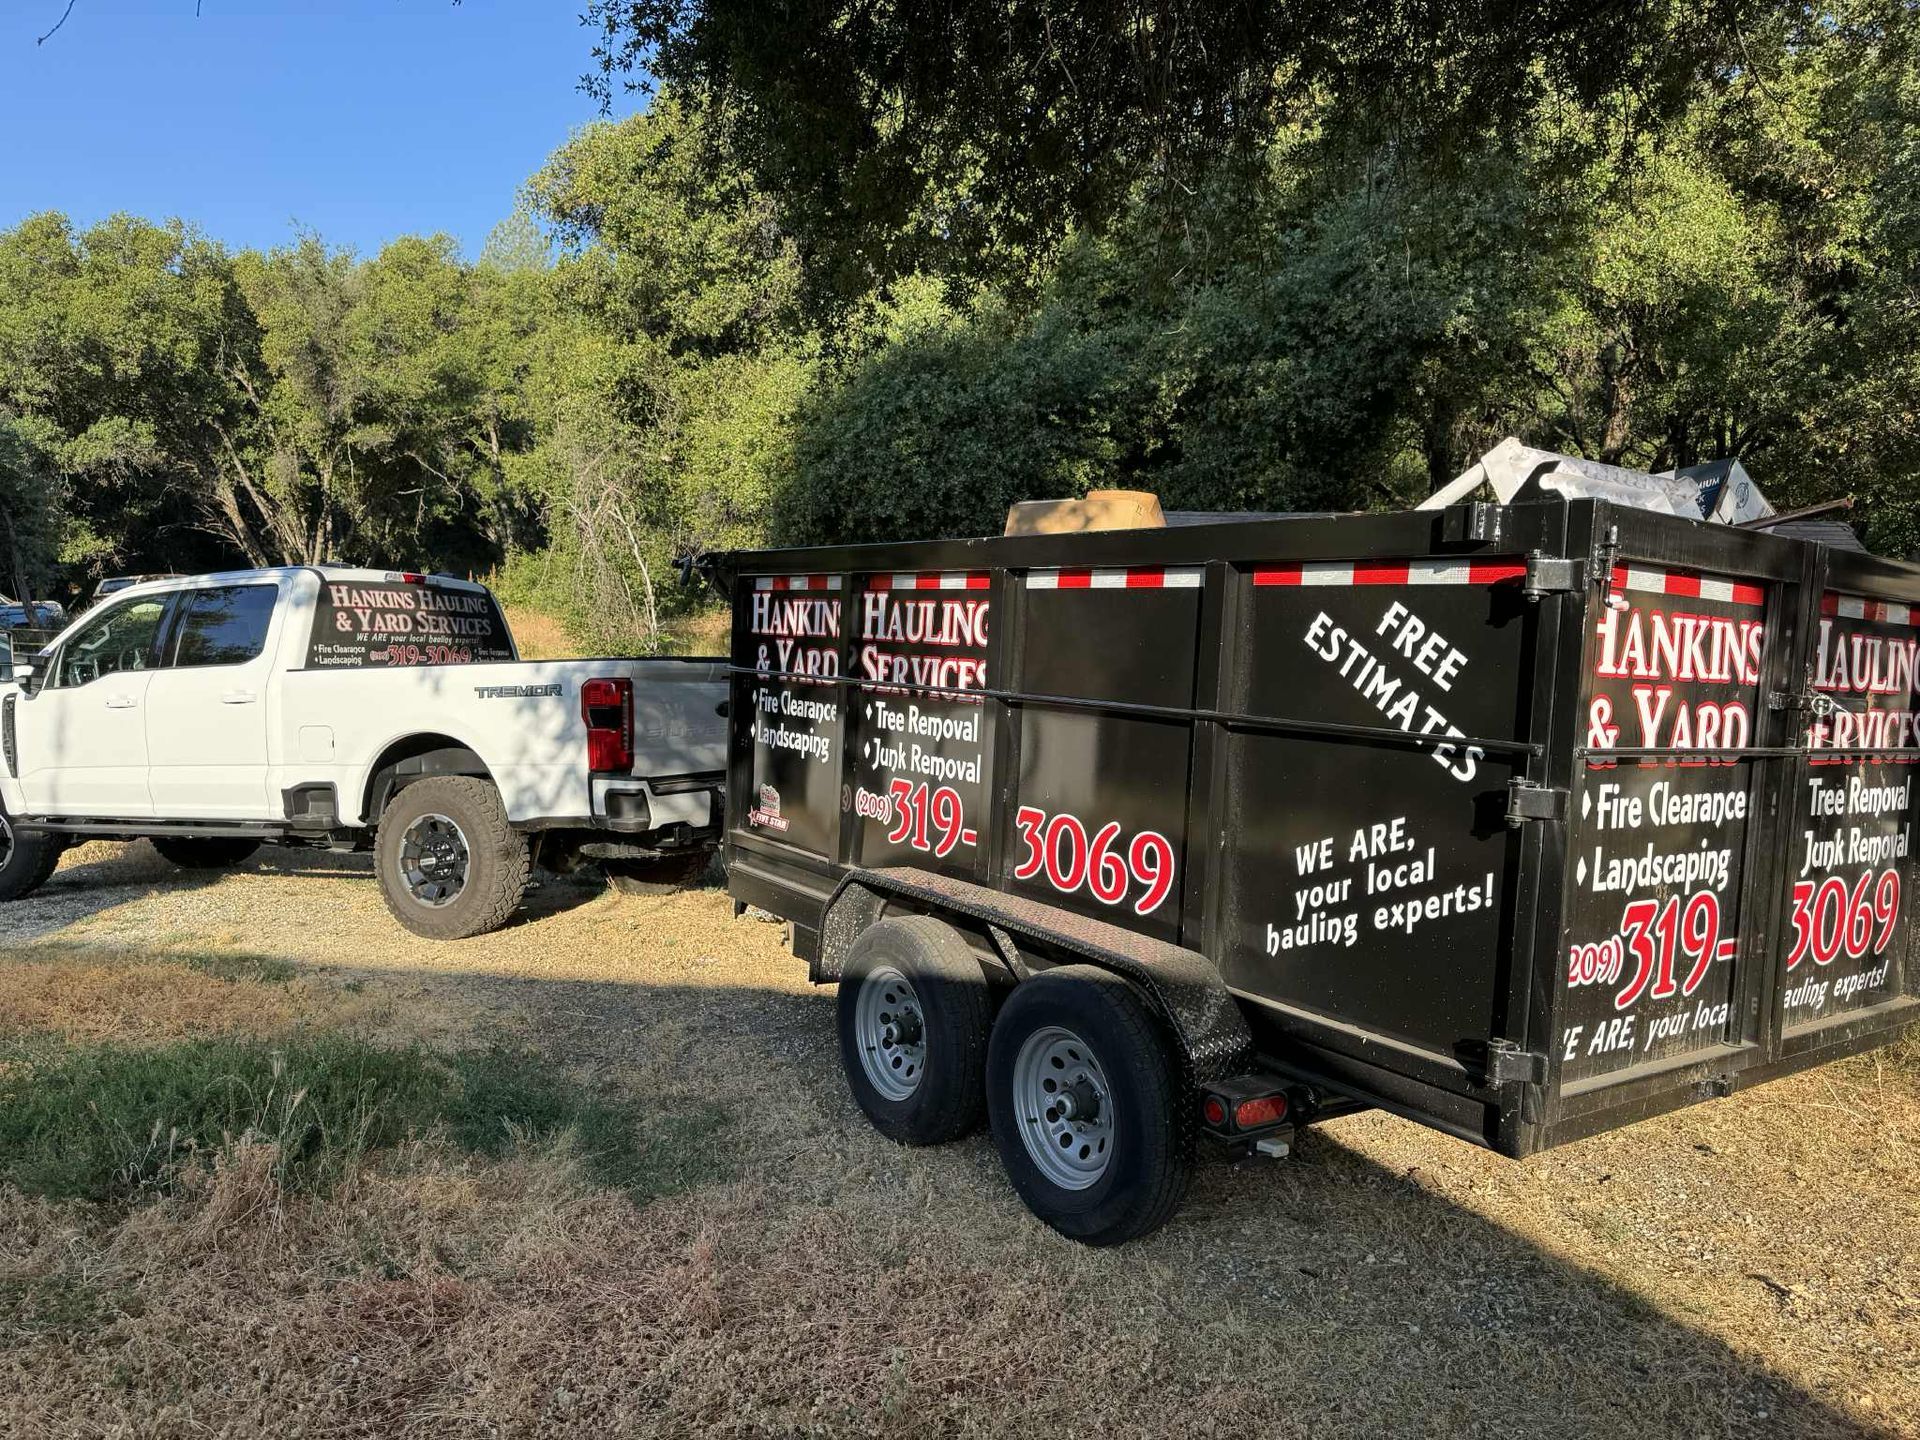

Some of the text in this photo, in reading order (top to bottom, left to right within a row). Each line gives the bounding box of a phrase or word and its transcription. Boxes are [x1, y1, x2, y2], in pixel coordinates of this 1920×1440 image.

[330, 585, 488, 613] HANKINS HAULING
[336, 609, 492, 635] & YARD SERVICES
[862, 591, 989, 647] HAULING
[318, 644, 366, 654] Fire Clearance
[319, 655, 362, 666] Landscaping
[356, 633, 370, 641] WE
[371, 633, 388, 641] ARE
[756, 643, 770, 680] &
[775, 638, 839, 684] YARD
[1376, 601, 1468, 692] FREE
[1597, 590, 1763, 686] HANKINS
[474, 684, 563, 698] TREMOR
[758, 688, 837, 725] Fire Clearance
[1303, 611, 1486, 782] ESTIMATES
[757, 723, 830, 763] Landscaping
[875, 701, 979, 743] Tree Removal
[1586, 695, 1620, 769] &
[1631, 684, 1750, 769] YARD
[871, 738, 982, 784] Junk Removal
[1597, 781, 1747, 830] Fire Clearance
[1809, 775, 1911, 818] Tree Removal
[855, 777, 1175, 915] (209) 319- 3069
[1295, 817, 1416, 876] WE ARE,
[1592, 838, 1732, 896] Landscaping
[1800, 822, 1910, 878] Junk Removal
[1295, 848, 1435, 921] your local
[1266, 873, 1494, 957] hauling experts!
[1567, 868, 1900, 1010] 209) 319- 3069
[1784, 959, 1889, 1010] auling experts!
[1562, 1000, 1729, 1061] E ARE, your loca
